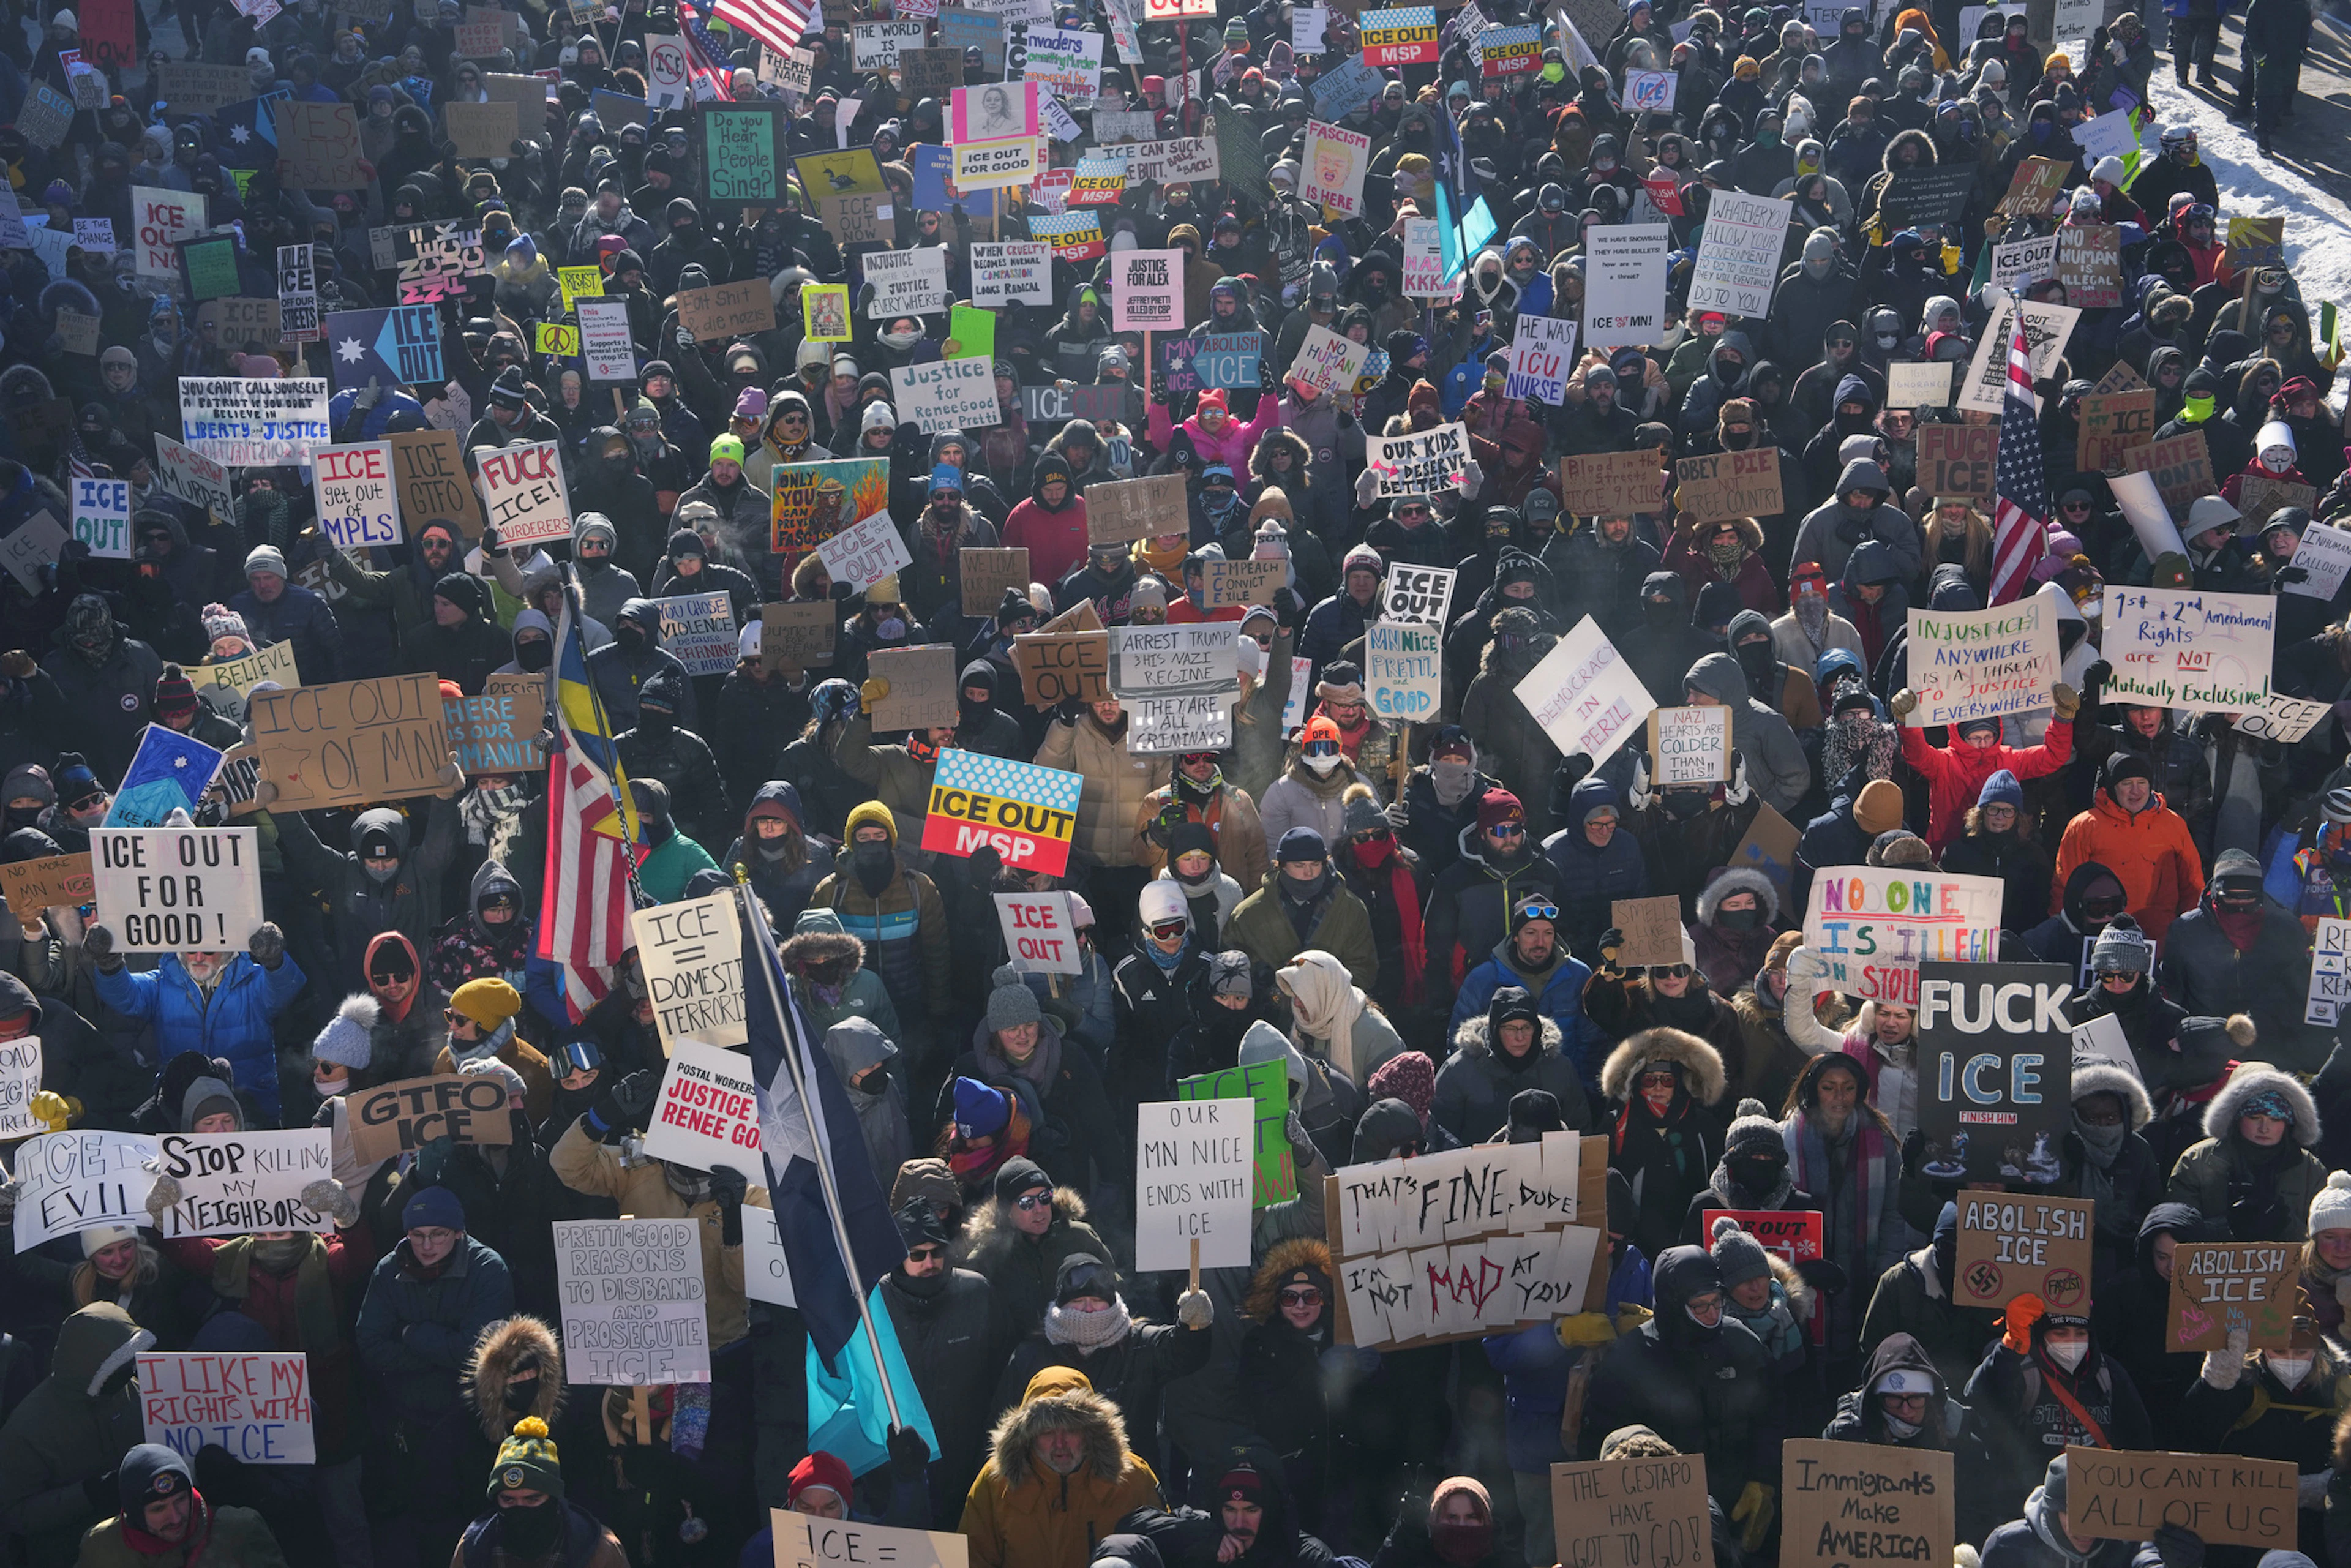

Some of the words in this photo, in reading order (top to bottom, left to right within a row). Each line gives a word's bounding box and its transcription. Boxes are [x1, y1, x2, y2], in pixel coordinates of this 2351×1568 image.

[1483, 47, 1505, 59] ICE
[1510, 42, 1540, 54] OUT
[1498, 58, 1529, 72] MSP
[714, 113, 733, 127] Do
[737, 115, 763, 129] you
[721, 127, 757, 142] Hear
[1310, 122, 1366, 148] FASCISM
[719, 146, 769, 176] People
[962, 164, 986, 174] FOR
[992, 160, 1029, 171] GOOD
[968, 154, 991, 163] ICE
[996, 151, 1022, 160] OUT
[714, 170, 772, 199] Sing?
[840, 198, 872, 214] ICE
[1307, 186, 1316, 198] IS
[1320, 190, 1354, 209] HERE
[76, 222, 87, 230] BE
[91, 221, 109, 230] THE
[841, 214, 872, 230] OUT
[78, 233, 113, 245] CHANGE
[844, 229, 876, 241] NOW
[2063, 229, 2084, 246] NO
[281, 248, 309, 269] KILLER
[974, 246, 1003, 257] WHEN
[1007, 245, 1046, 257] CRUELTY
[1997, 255, 2019, 269] ICE
[2024, 246, 2052, 263] OUT
[2060, 250, 2117, 266] HUMAN
[974, 258, 1007, 268] BECOMES
[1011, 257, 1040, 266] NORMAL
[1128, 260, 1167, 272] JUSTICE
[2011, 262, 2050, 276] MINNESOTA
[2081, 264, 2093, 274] IS
[280, 269, 311, 292] ICE
[566, 271, 596, 289] RESIST
[982, 269, 1032, 279] COMPASSION
[1127, 273, 1146, 285] FOR
[1147, 273, 1169, 285] ALEX
[2063, 273, 2113, 287] ILLEGAL
[976, 285, 1000, 294] LOOKS
[1004, 282, 1040, 294] RADICAL
[282, 298, 296, 306] OFF
[299, 297, 315, 306] OUR
[1127, 296, 1153, 305] JEFFREY
[1153, 296, 1171, 305] PRETTI
[282, 306, 317, 330] STREETS
[396, 308, 436, 345] ICE
[1593, 317, 1613, 329] ICE
[1630, 316, 1652, 327] MN!
[1520, 318, 1541, 338] HE
[1547, 321, 1573, 343] WAS
[590, 340, 621, 348] Supports
[1532, 342, 1547, 351] AN
[399, 343, 444, 383] OUT
[904, 362, 984, 386] Justice
[1518, 351, 1559, 377] ICU
[935, 384, 960, 400] for
[1506, 373, 1561, 400] NURSE
[915, 403, 958, 418] Renee
[961, 397, 994, 410] Good
[922, 419, 953, 432] Alex
[959, 411, 997, 427] Pretti
[1382, 440, 1414, 459] OUR
[1425, 429, 1459, 454] KIDS
[318, 450, 386, 481] ICE
[483, 449, 557, 490] FUCK
[1404, 452, 1466, 476] DESERVE
[325, 486, 351, 506] get
[356, 483, 384, 500] out
[1380, 478, 1450, 495] BETTER
[347, 501, 362, 517] of
[493, 481, 561, 525] ICE!
[324, 513, 394, 545] MPLS
[497, 517, 571, 539] MURDERERS
[1917, 616, 2031, 642] INJUSTICE
[1935, 640, 2032, 665] ANYWHERE
[1923, 672, 1938, 685] IS
[1954, 670, 1963, 681] A
[1983, 656, 2040, 678] THREAT
[1918, 688, 1944, 703] TO
[1965, 676, 2038, 699] JUSTICE
[1674, 711, 1706, 724] NAZI
[1934, 692, 2050, 722] EVERYWHERE
[1659, 725, 1700, 737] HEARTS
[1705, 724, 1723, 734] ARE
[1661, 737, 1722, 754] COLDER
[1670, 757, 1704, 768] THAN
[1670, 763, 1714, 779] THIS!!
[932, 788, 991, 822] ICE
[997, 802, 1074, 838] OUT
[103, 836, 146, 868] ICE
[180, 834, 240, 867] OUT
[956, 827, 1035, 862] MSP
[138, 875, 203, 907] FOR
[126, 913, 203, 945] GOOD
[1919, 980, 2073, 1033] FUCK
[677, 1062, 710, 1082] POSTAL
[1938, 1052, 2044, 1103] ICE
[668, 1078, 754, 1120] JUSTICE
[661, 1101, 727, 1139] RENEE
[1170, 1105, 1220, 1127] OUR
[1960, 1111, 1993, 1123] FINISH
[1997, 1113, 2017, 1124] HIM
[163, 1136, 244, 1178] STOP
[255, 1144, 328, 1174] KILLING
[1145, 1141, 1177, 1168] MN
[1192, 1137, 1242, 1164] NICE
[223, 1180, 257, 1196] MY
[1146, 1184, 1191, 1205] ENDS
[1200, 1177, 1243, 1200] WITH
[1178, 1214, 1212, 1236] ICE
[1965, 1202, 2086, 1240] ABOLISH
[1995, 1234, 2048, 1266] ICE
[2074, 1462, 2133, 1489] YOU
[2140, 1465, 2221, 1489] CAN'T
[2232, 1469, 2293, 1490] KILL
[2081, 1494, 2154, 1526] ALL
[2162, 1499, 2211, 1526] OF
[2226, 1503, 2281, 1536] US
